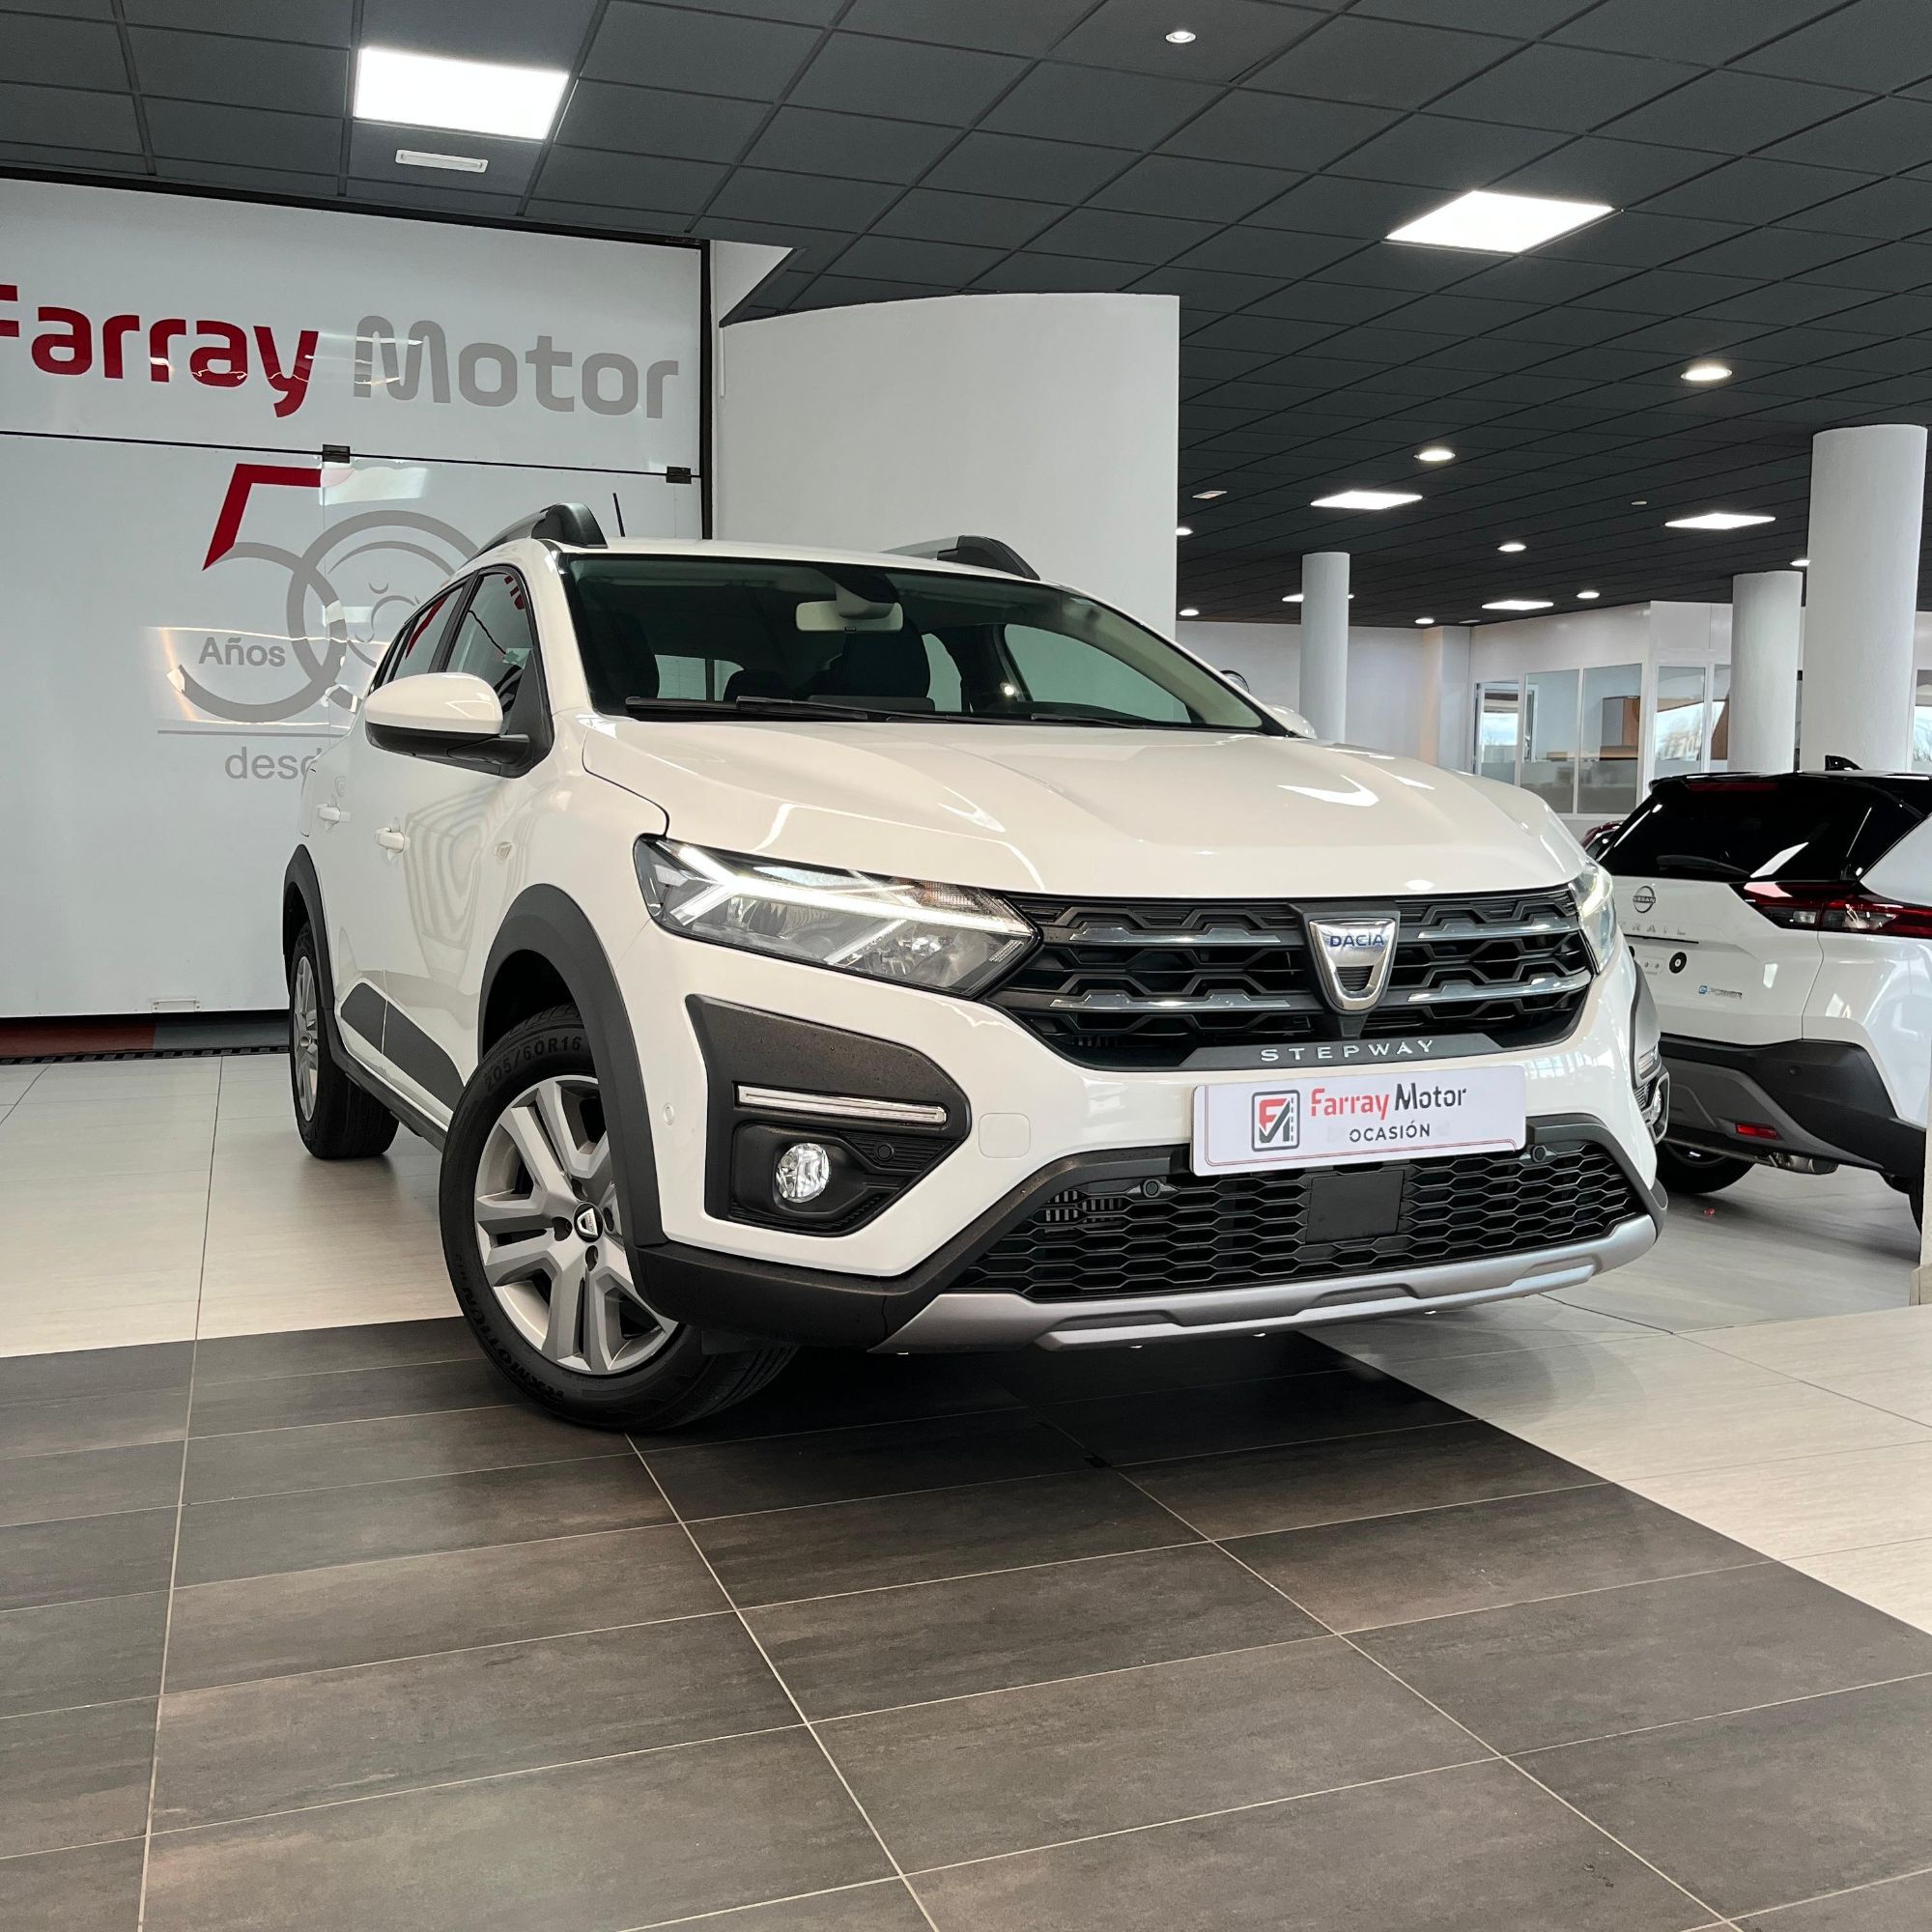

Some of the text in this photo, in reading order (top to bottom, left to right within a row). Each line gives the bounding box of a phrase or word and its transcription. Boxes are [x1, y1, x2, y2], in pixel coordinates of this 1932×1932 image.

[0, 284, 680, 419] array Motor
[198, 637, 286, 668] Años
[1329, 933, 1385, 949] DACIA
[484, 1036, 582, 1093] 205/60R16
[1261, 1039, 1434, 1063] STEPWAY
[1311, 1088, 1390, 1121] Farray
[1394, 1083, 1466, 1111] Motor
[1349, 1121, 1431, 1143] OCASIÓN
